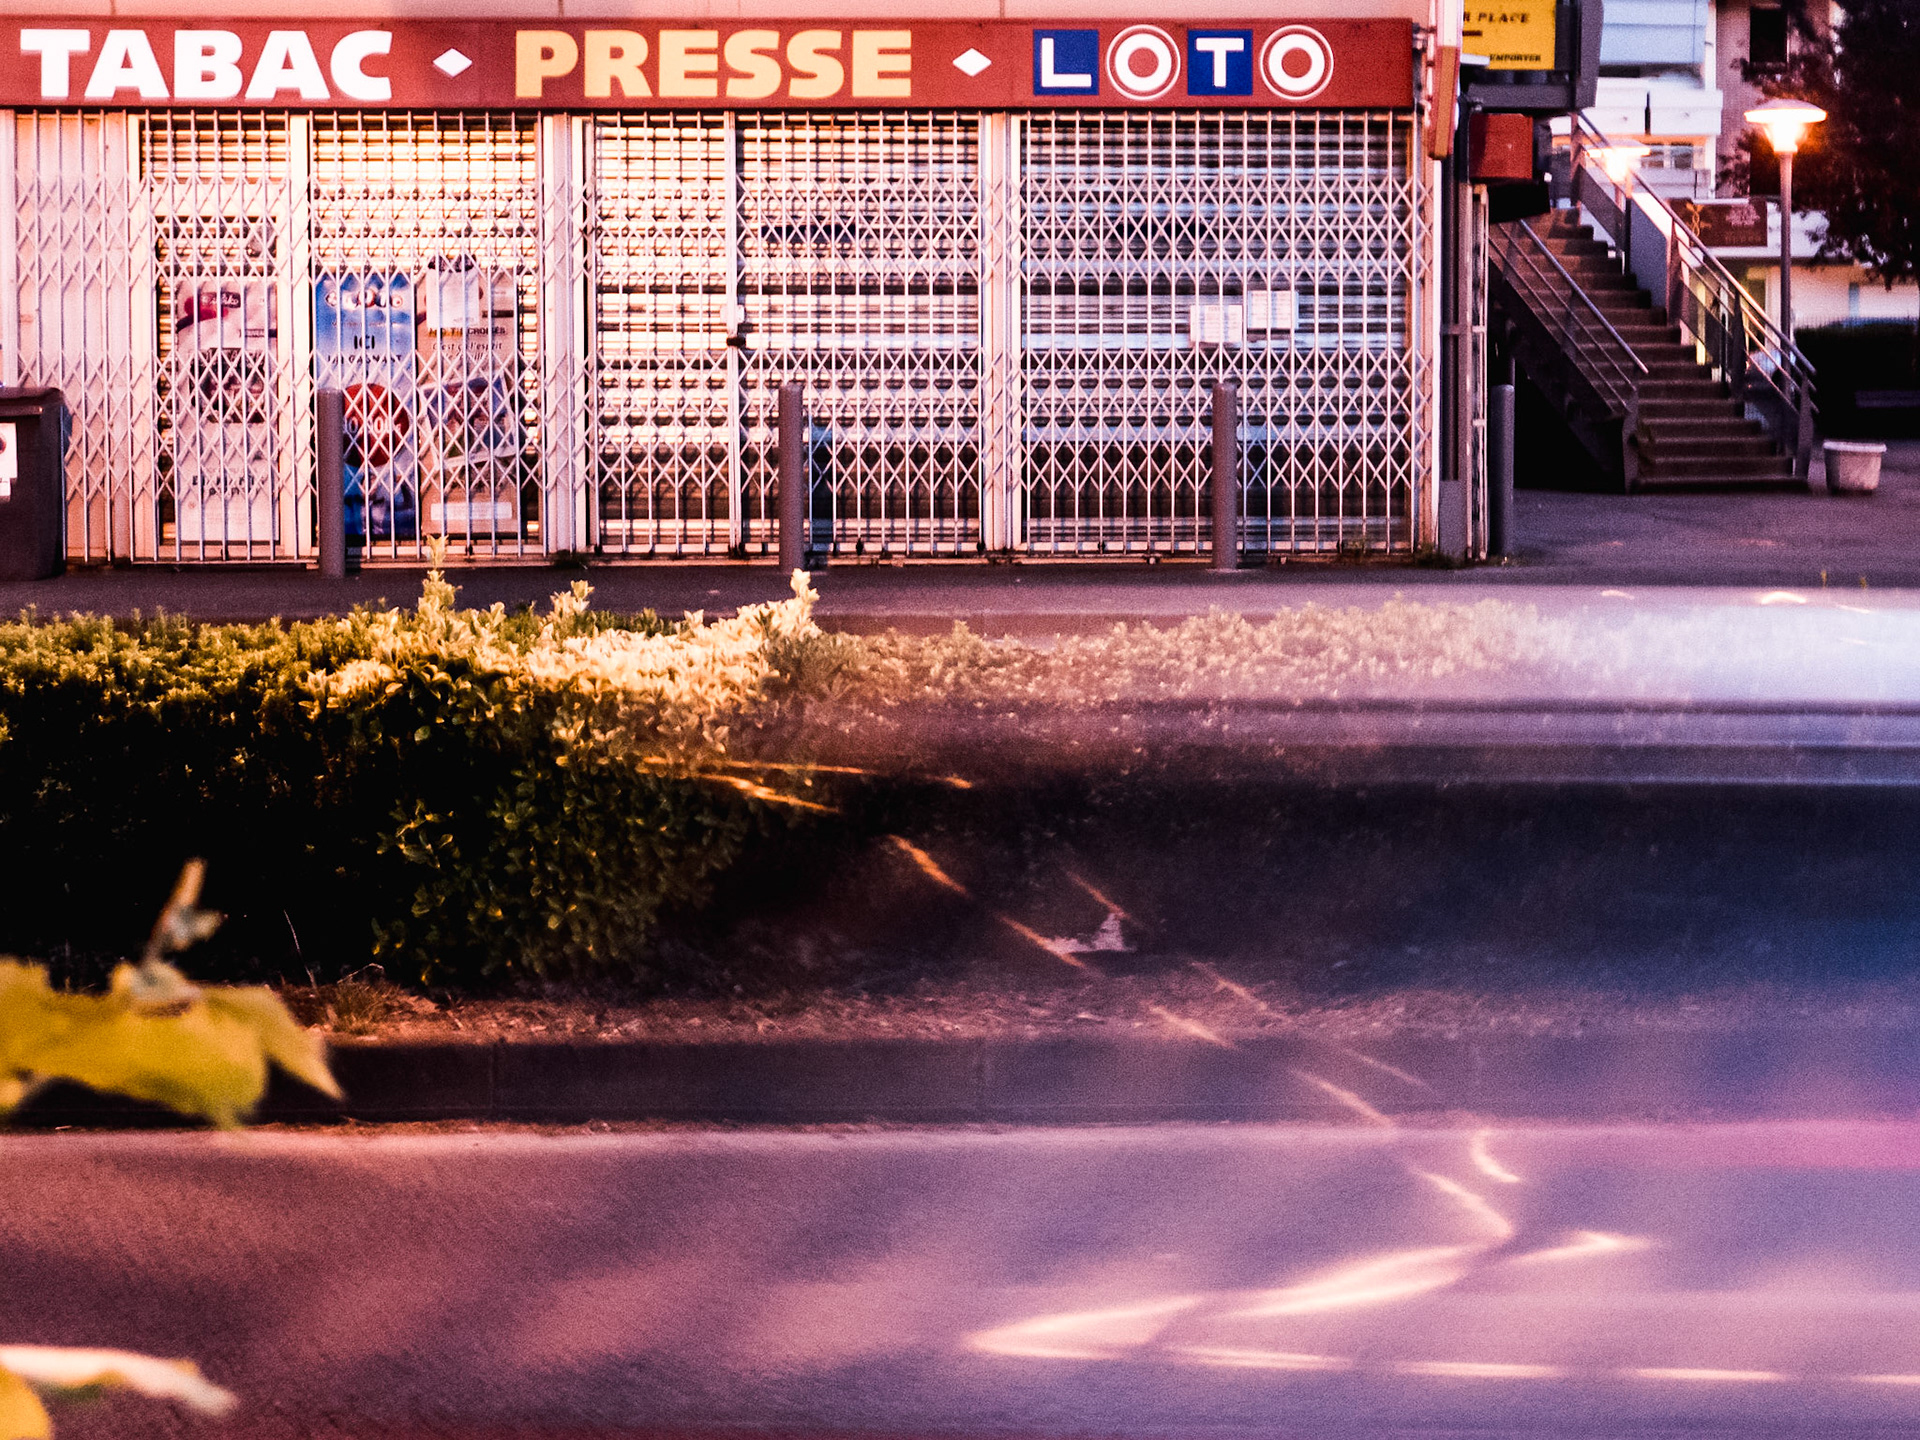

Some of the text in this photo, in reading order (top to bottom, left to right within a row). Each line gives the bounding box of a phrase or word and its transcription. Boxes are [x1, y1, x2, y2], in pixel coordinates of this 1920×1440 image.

[1478, 12, 1529, 24] PLACE
[19, 24, 1335, 102] TABAC PRESSE LOTO
[1489, 53, 1541, 63] EMPORTER
[353, 334, 375, 350] ICI
